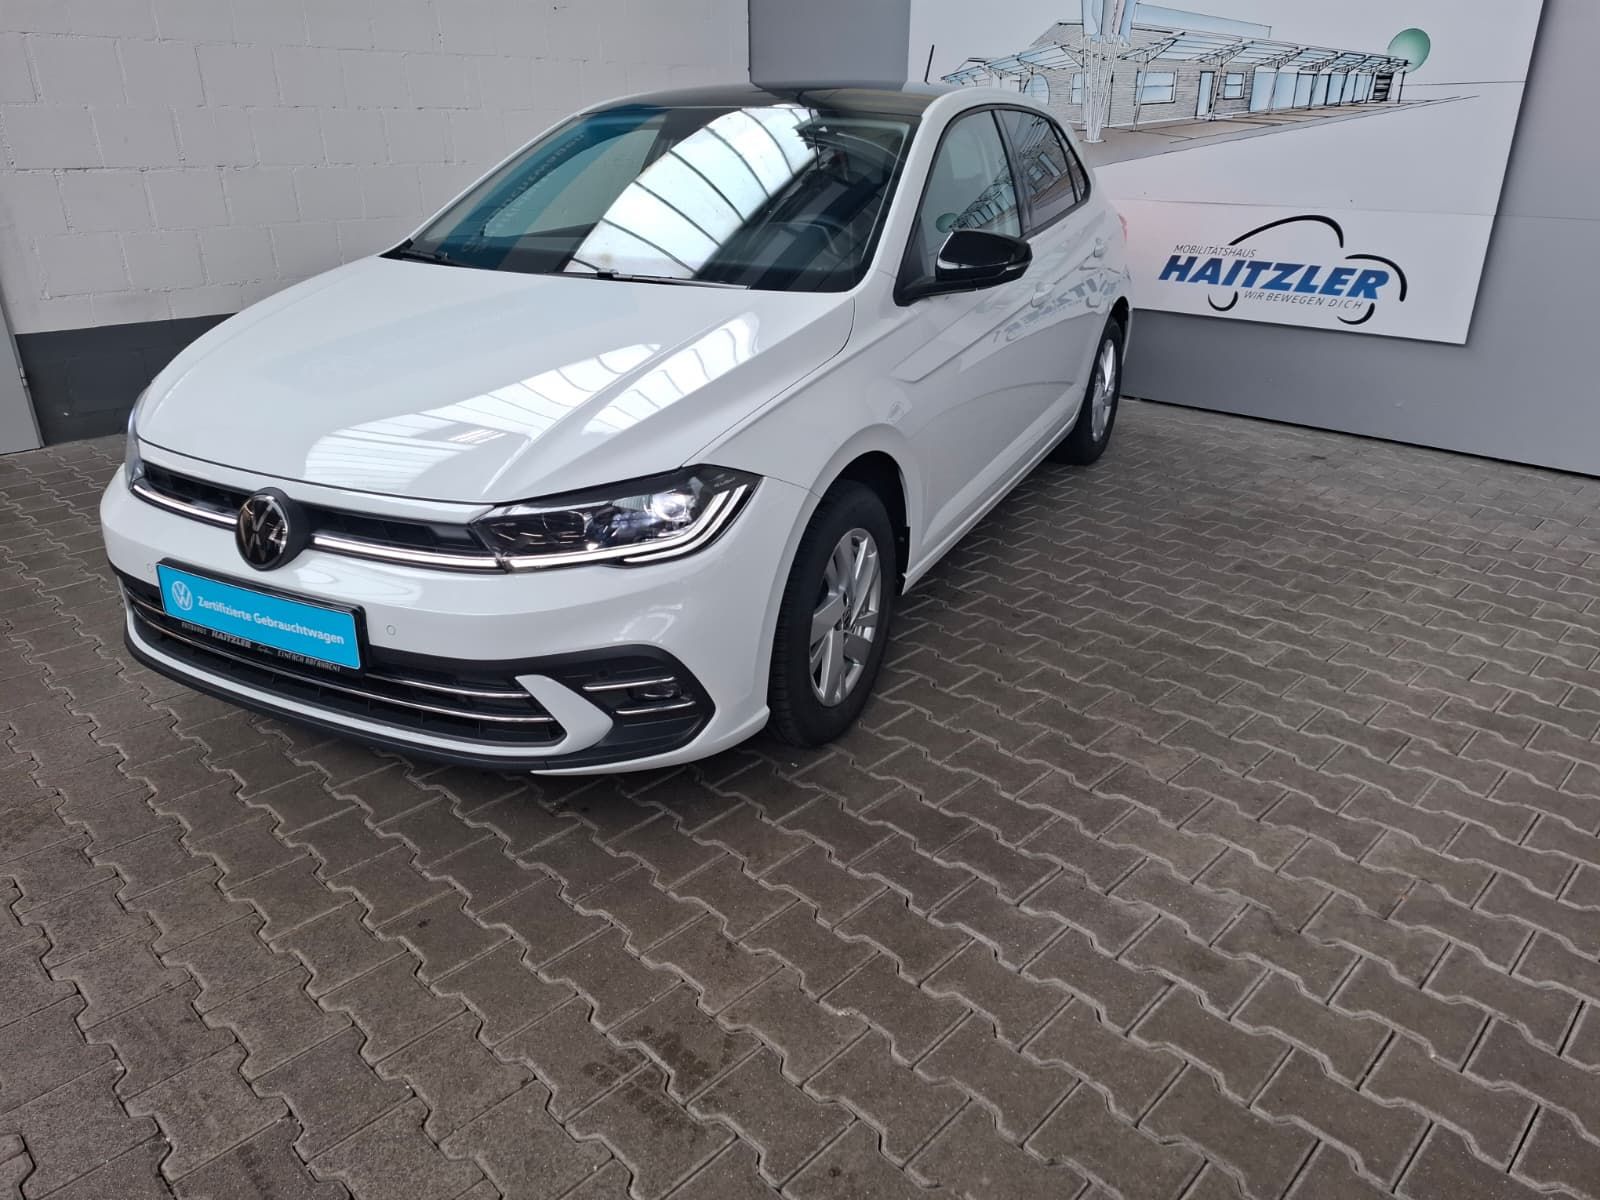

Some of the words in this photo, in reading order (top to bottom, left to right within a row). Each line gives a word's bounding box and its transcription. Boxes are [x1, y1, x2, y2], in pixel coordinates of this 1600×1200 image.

[1158, 254, 1389, 300] HAITZLER
[1243, 290, 1265, 300] WIR
[1266, 292, 1325, 306] BEWEGEN
[1328, 298, 1363, 310] DICH
[197, 595, 252, 622] Zertifizierte
[253, 612, 345, 645] Gebrauchtwagen
